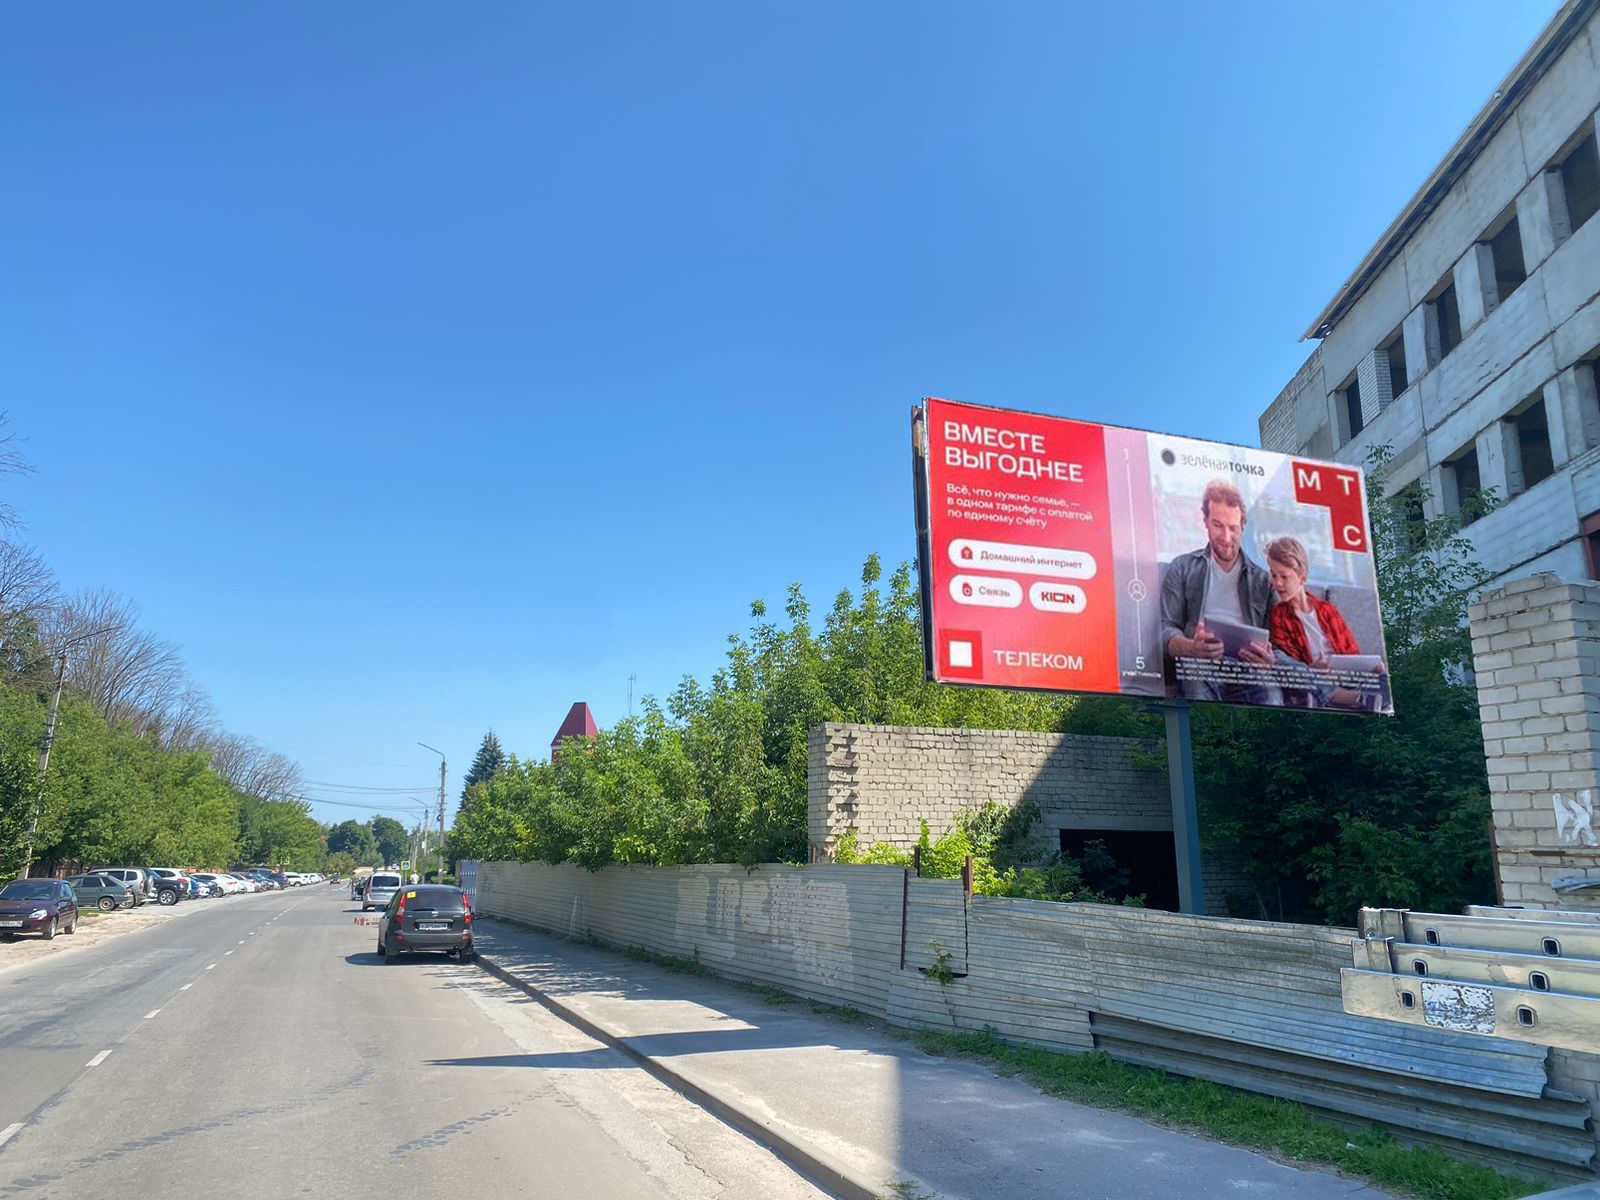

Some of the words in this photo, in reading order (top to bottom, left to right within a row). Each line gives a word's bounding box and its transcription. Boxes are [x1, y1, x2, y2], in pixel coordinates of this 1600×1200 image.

[944, 421, 1046, 454] ВМЕСТЕ
[945, 446, 1084, 482] ВЫГОДНЕЕ
[946, 483, 971, 497] Всё,
[972, 488, 992, 498] что
[994, 491, 1031, 503] нужно
[1032, 495, 1069, 508] семье,
[947, 497, 954, 505] в
[956, 498, 994, 510] одном
[996, 502, 1038, 516] тарифе
[1039, 508, 1046, 516] с
[1047, 509, 1093, 522] оплатой
[947, 509, 962, 518] по
[964, 510, 1014, 526] единому
[1016, 515, 1048, 529] счёту
[980, 550, 1036, 565] Домашний
[1037, 557, 1083, 570] интернет
[978, 585, 1011, 598] Связь
[993, 649, 1084, 671] ТЕЛЕКОМ
[1135, 656, 1146, 670] 5
